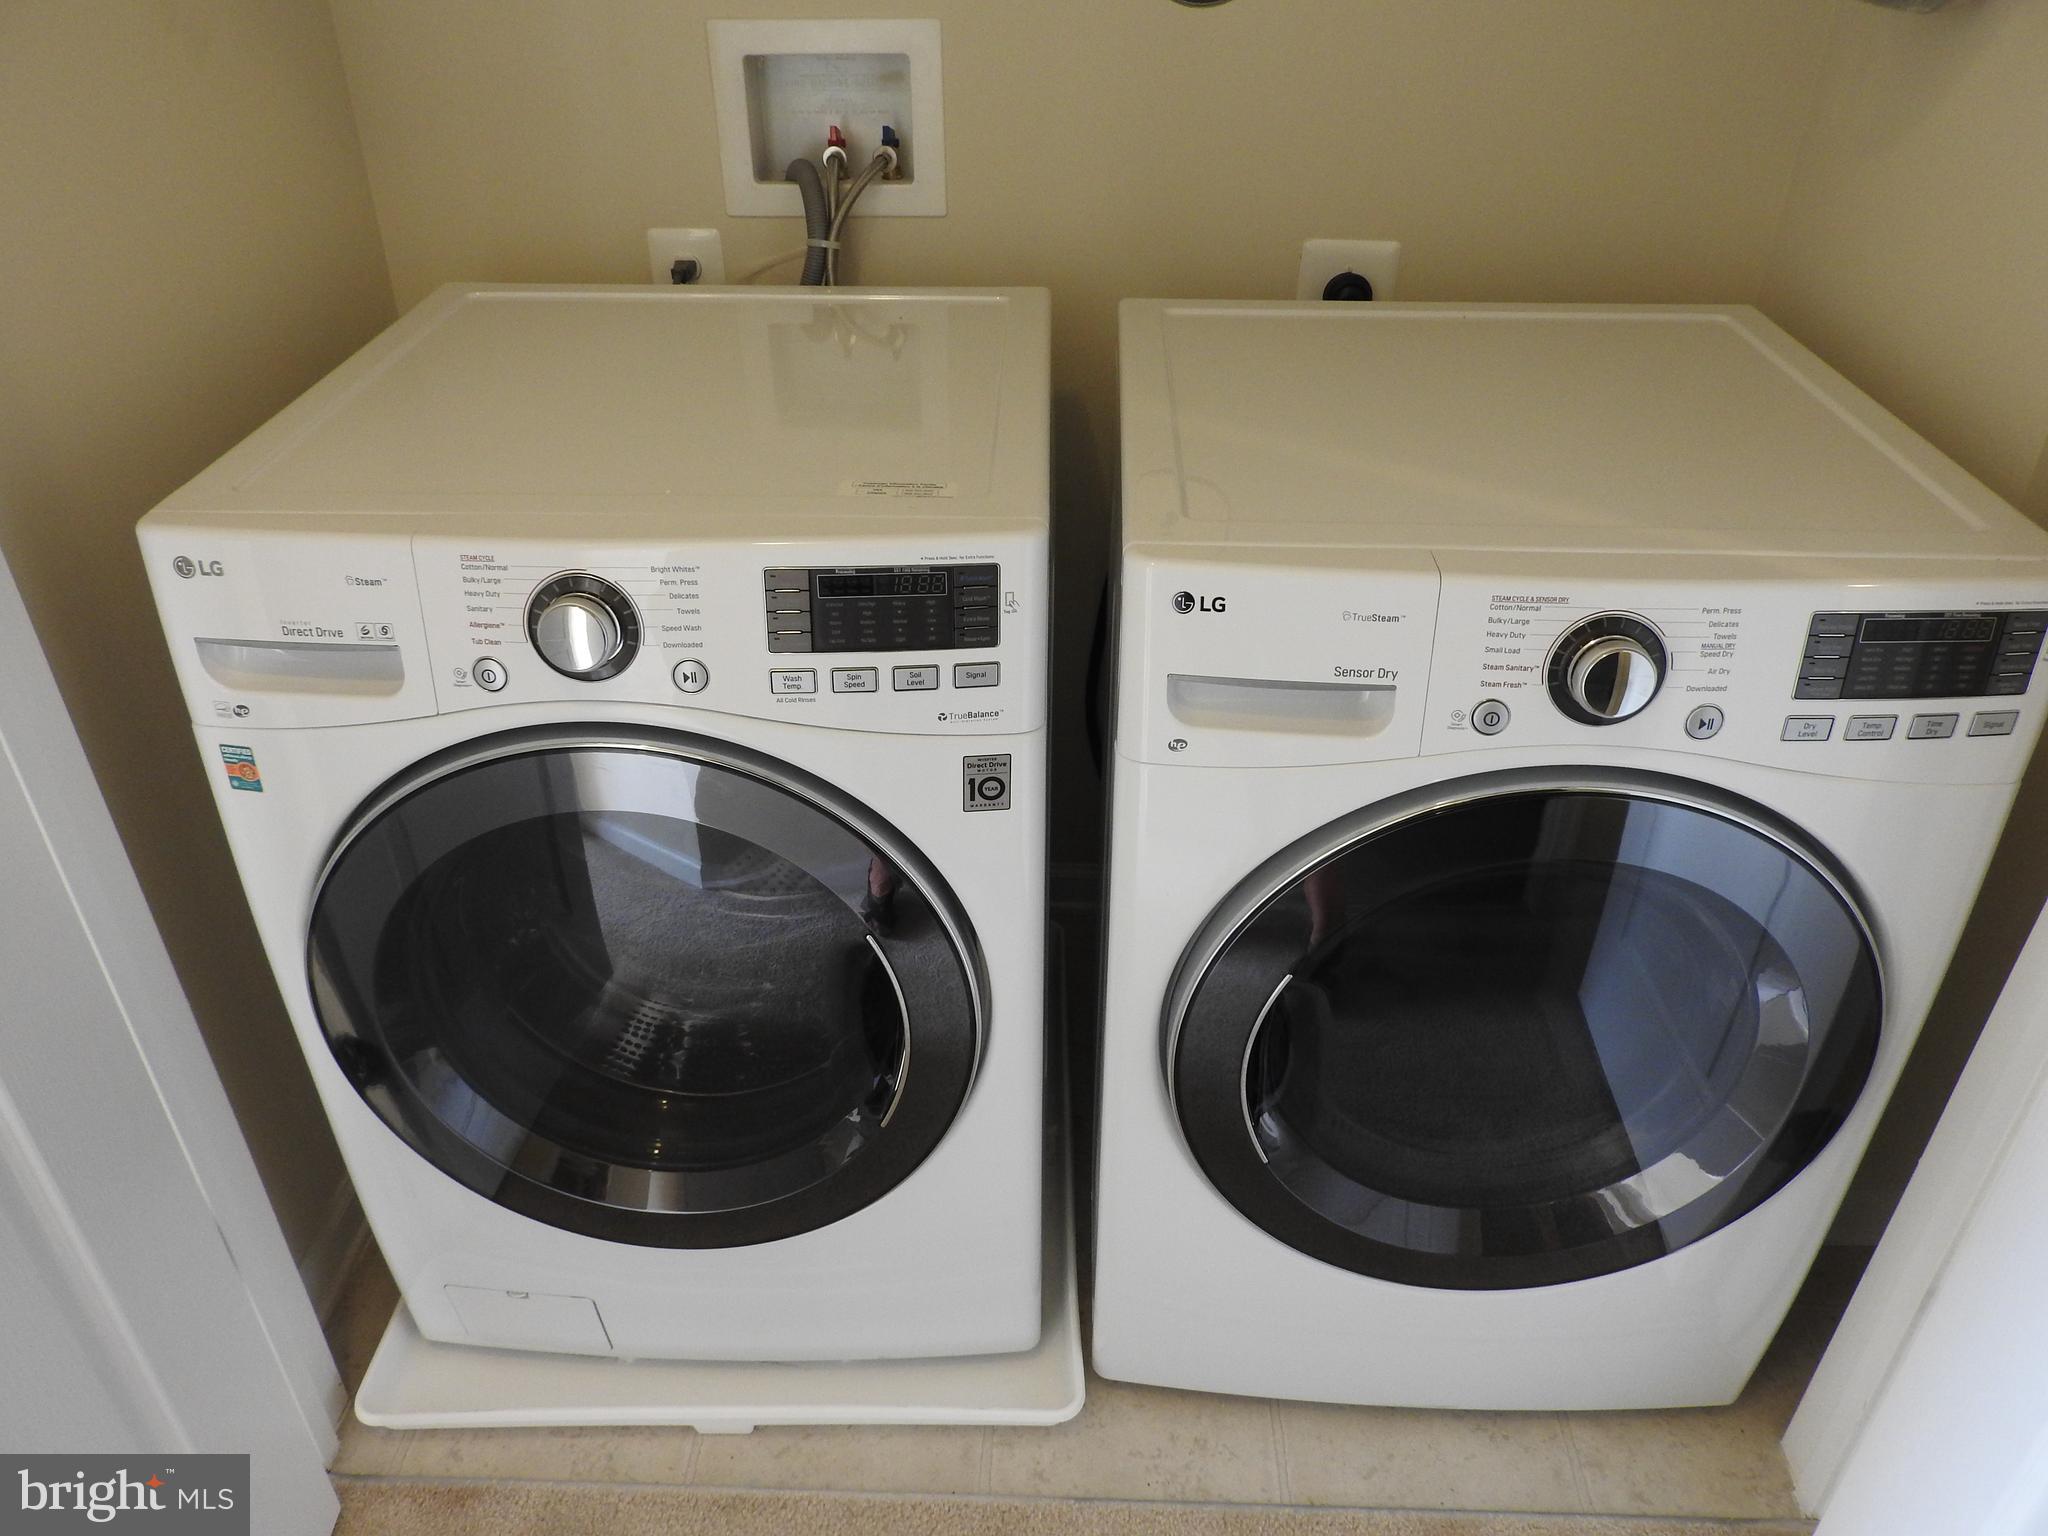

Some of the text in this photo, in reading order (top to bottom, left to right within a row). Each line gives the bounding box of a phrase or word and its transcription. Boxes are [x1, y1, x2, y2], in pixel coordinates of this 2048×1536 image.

[198, 560, 225, 576] LG
[461, 563, 508, 571] Cotton/Normal
[650, 565, 671, 574] Bright
[463, 576, 501, 585] Bulky/Large
[464, 590, 500, 598] Heavy Duty
[669, 592, 700, 600] Delicates
[466, 604, 493, 613] Sanitary
[1199, 596, 1227, 613] LG
[1489, 603, 1542, 612] Cotton/Normal
[677, 607, 701, 615] Towels
[1722, 607, 1742, 615] Press
[1487, 616, 1530, 626] Bulky/Large
[1708, 620, 1740, 628] Delicates
[282, 625, 344, 638] Direct Drive
[661, 624, 702, 632] Speed Wash
[1486, 631, 1526, 640] Heavy Duty
[1713, 632, 1737, 640] Towels
[472, 637, 502, 646] Tub Clean
[663, 640, 704, 649] Downloaded
[1700, 650, 1734, 658] Speed Dry
[1482, 663, 1504, 671] Steam
[1718, 667, 1731, 675] Dry
[846, 673, 862, 681] Spin
[909, 671, 922, 679] Soil
[965, 671, 987, 680] Signal
[1334, 665, 1399, 681] Sensor Dry
[782, 675, 803, 683] Wash
[843, 681, 866, 689] Speed
[1480, 680, 1502, 688] Steam
[1803, 722, 1816, 731] Dry
[1862, 721, 1882, 730] Temp
[1857, 730, 1885, 738] Control
[1924, 728, 1939, 736] Dry
[967, 776, 1006, 802] 10
